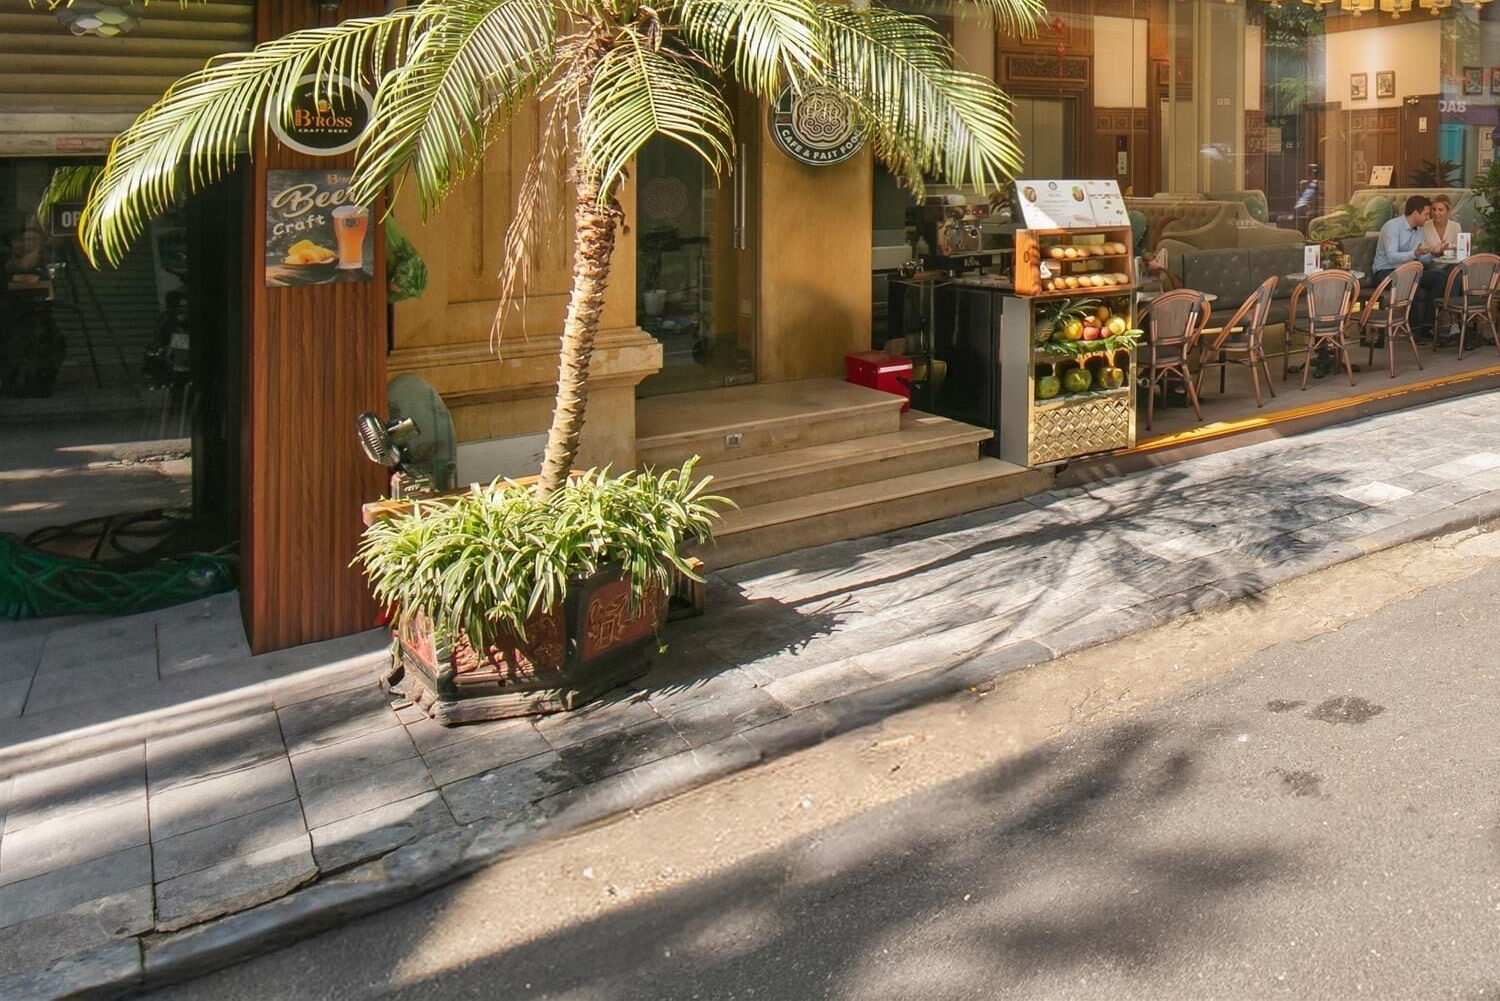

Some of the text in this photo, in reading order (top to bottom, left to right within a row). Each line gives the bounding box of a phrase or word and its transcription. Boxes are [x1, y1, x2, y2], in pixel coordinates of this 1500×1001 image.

[295, 106, 353, 128] B'ROSS
[781, 129, 803, 153] CAFE
[803, 148, 811, 158] &
[813, 149, 838, 160] FAST
[272, 214, 326, 235] Craft
